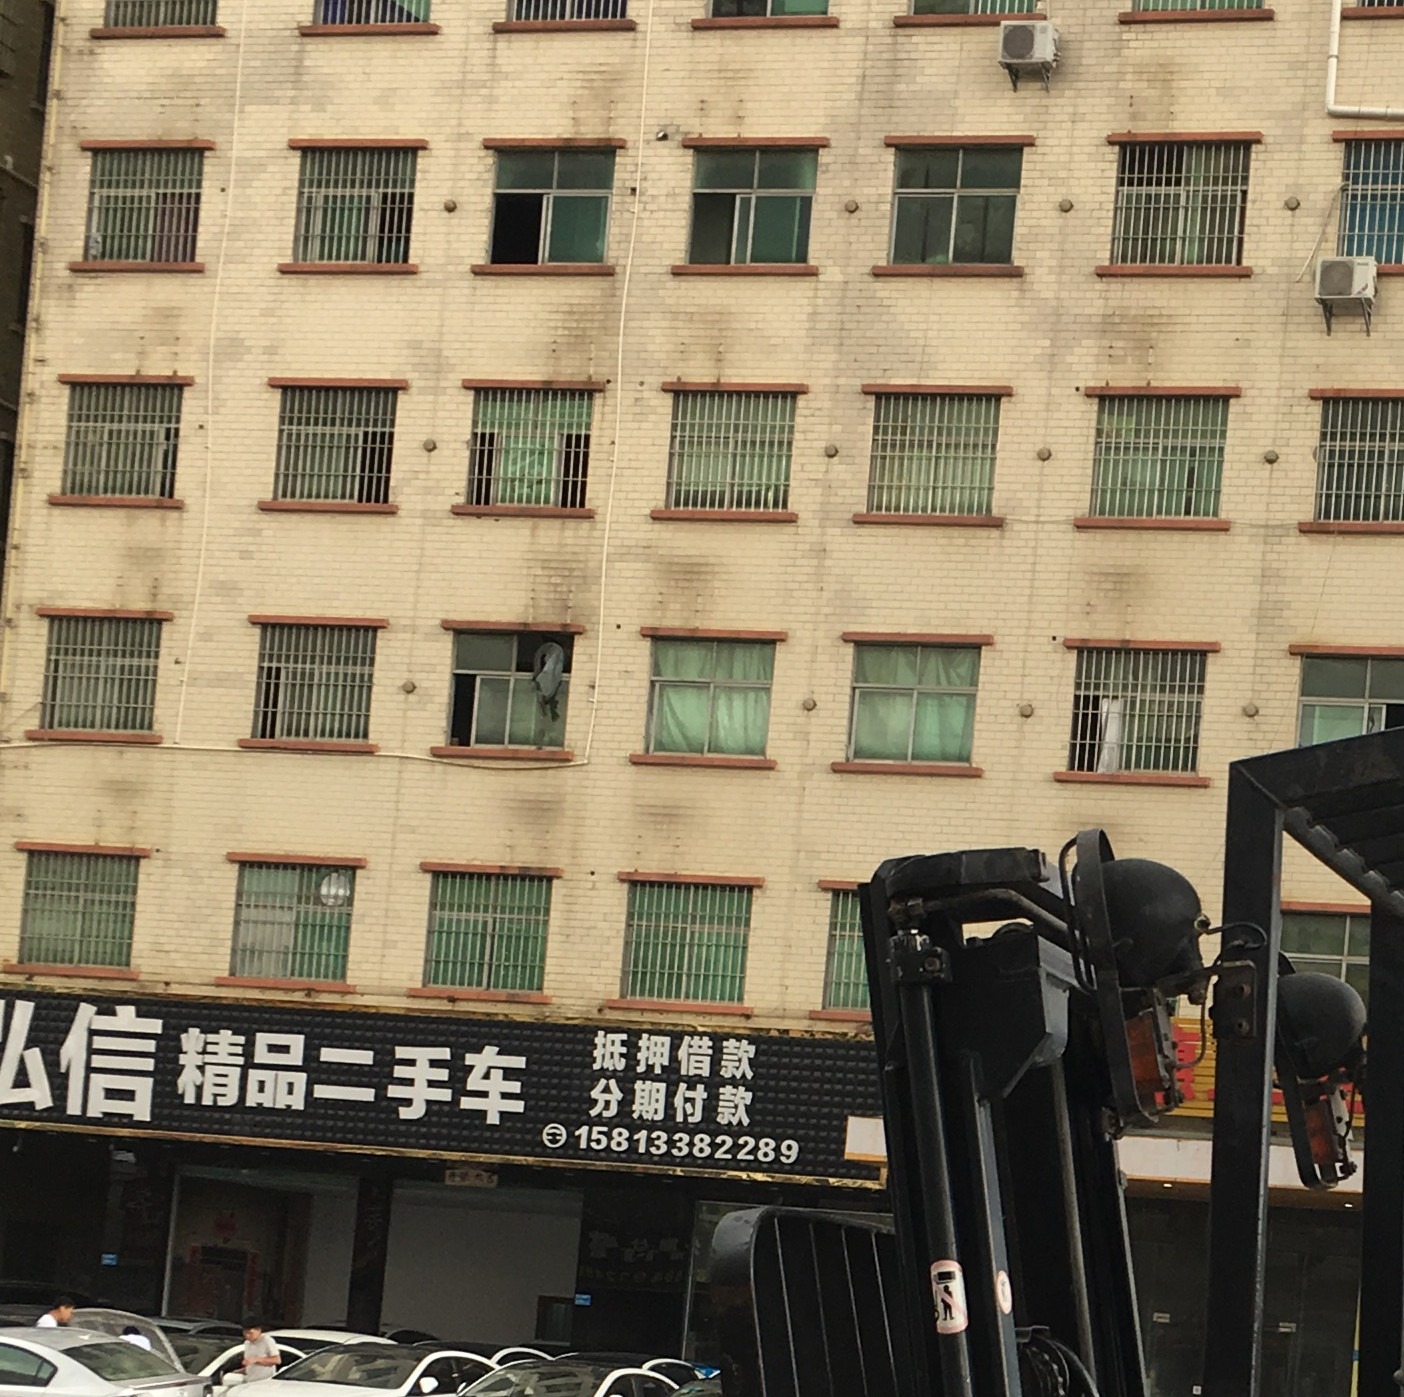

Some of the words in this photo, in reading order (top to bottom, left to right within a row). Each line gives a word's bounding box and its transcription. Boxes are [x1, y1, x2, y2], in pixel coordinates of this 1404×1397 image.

[177, 1027, 527, 1125] 精品二手车
[592, 1031, 756, 1080] 抵押借款
[589, 1078, 753, 1127] 分期付款
[574, 1125, 799, 1164] 15813382289
